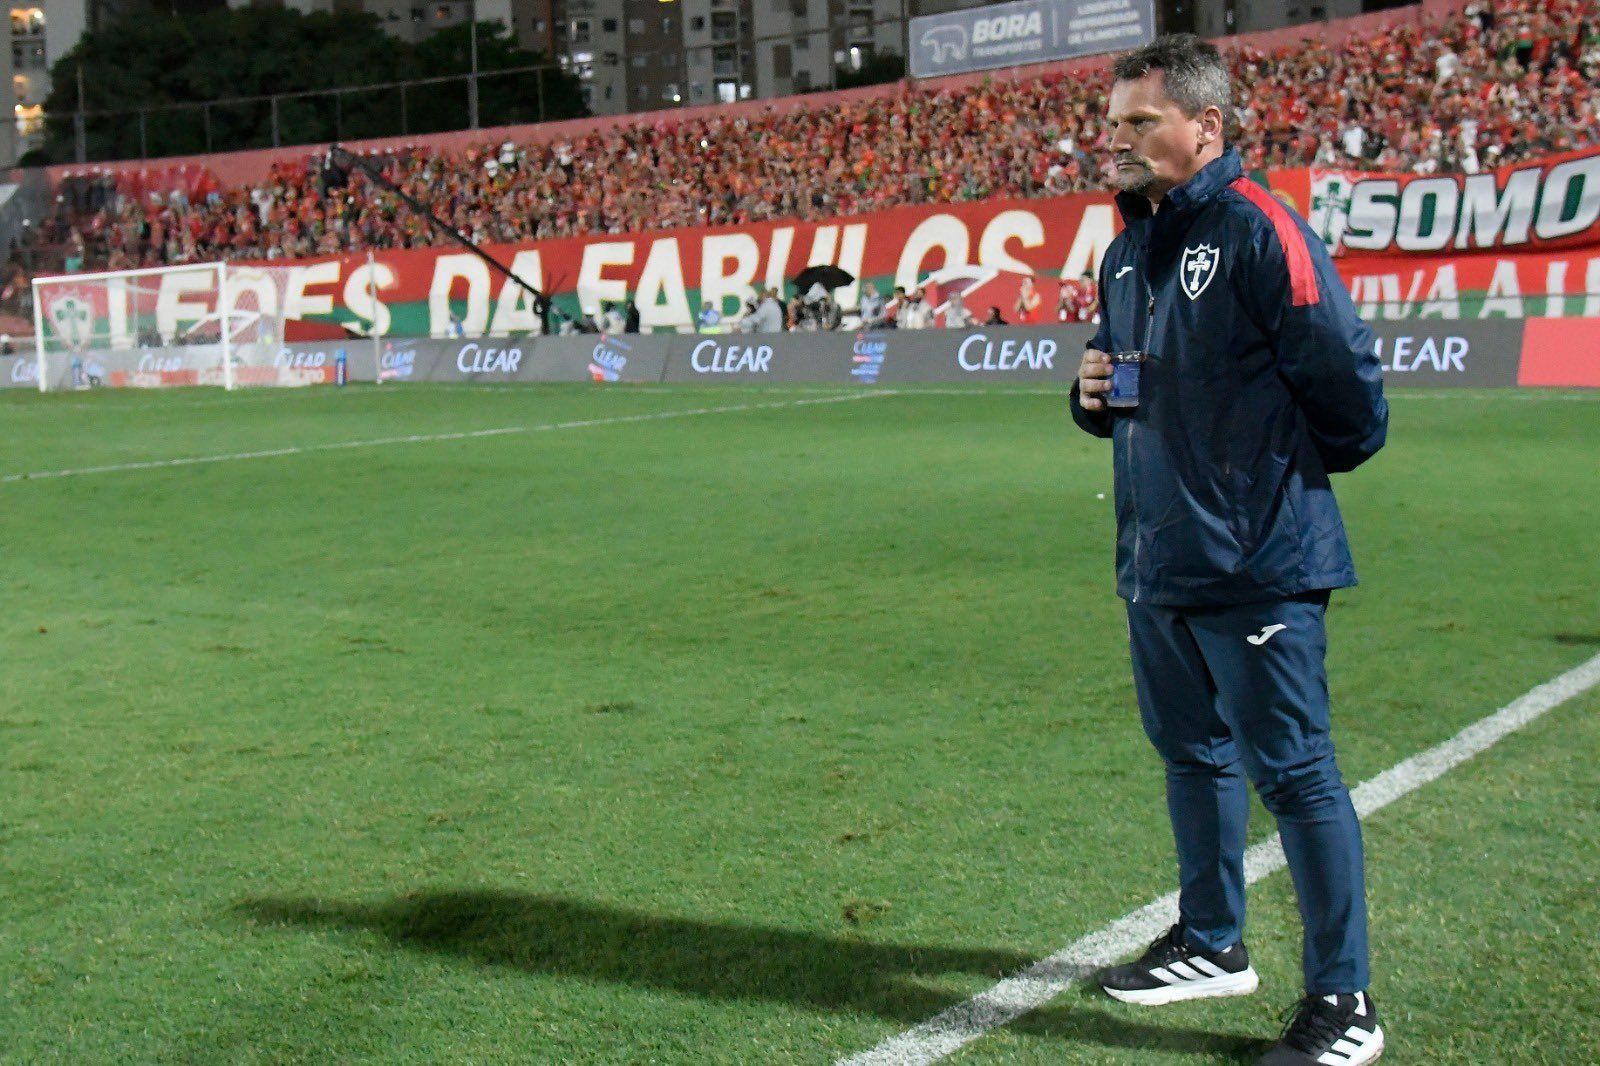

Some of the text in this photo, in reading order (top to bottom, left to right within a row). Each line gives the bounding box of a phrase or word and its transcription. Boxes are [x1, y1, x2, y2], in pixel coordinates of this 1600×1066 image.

[972, 11, 1042, 44] BORA
[429, 250, 543, 338] DA
[457, 343, 522, 372] CLEAR
[691, 340, 774, 373] CLEAR
[958, 333, 1057, 371] CLEAR
[1374, 336, 1469, 372] LEAR
